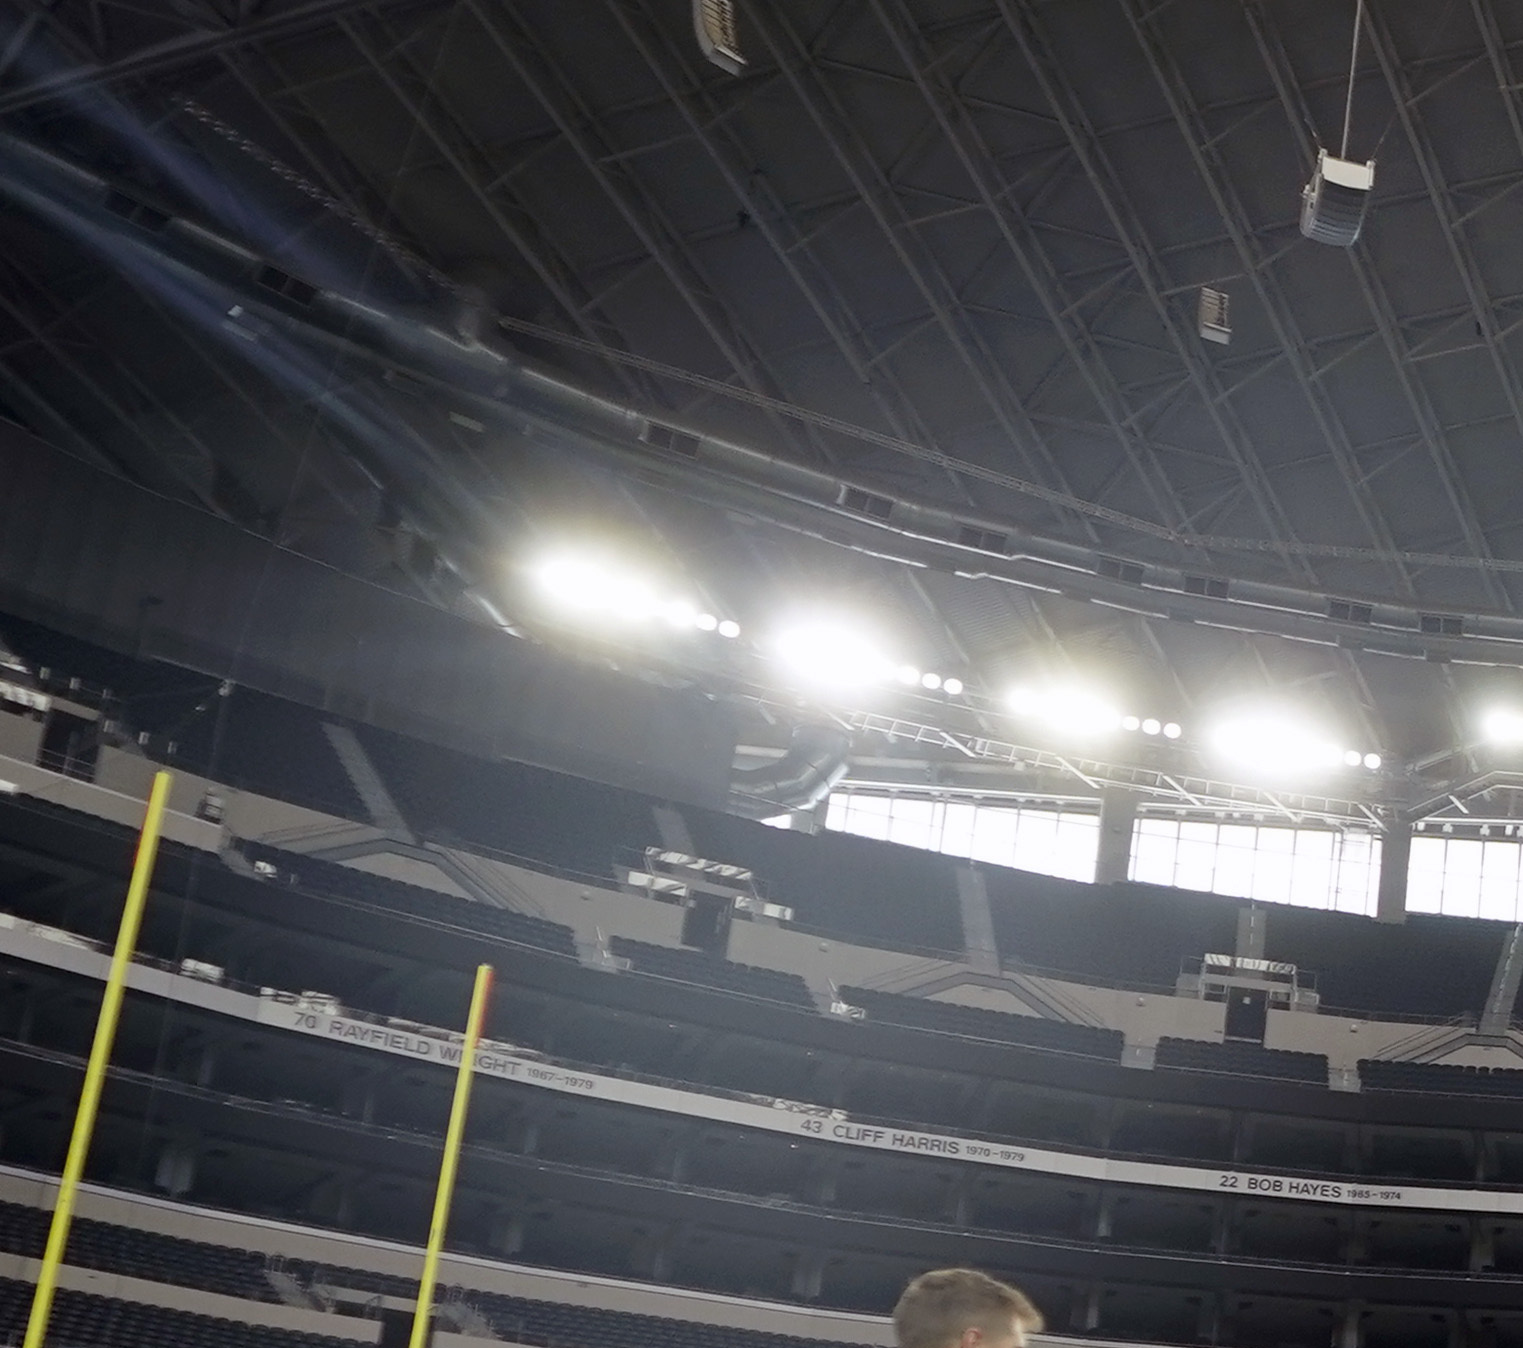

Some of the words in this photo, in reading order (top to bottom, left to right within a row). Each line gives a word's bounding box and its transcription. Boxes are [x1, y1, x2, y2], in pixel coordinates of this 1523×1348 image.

[293, 1012, 317, 1029] 70
[328, 1020, 430, 1055] RAYFIELD
[439, 1045, 522, 1076] WIGHT
[801, 1119, 822, 1133] 43
[833, 1124, 885, 1143] CLIFF
[892, 1133, 960, 1154] HARRIS
[1219, 1175, 1238, 1188] 22
[1247, 1177, 1283, 1192] BOB
[1288, 1183, 1342, 1198] HAYES
